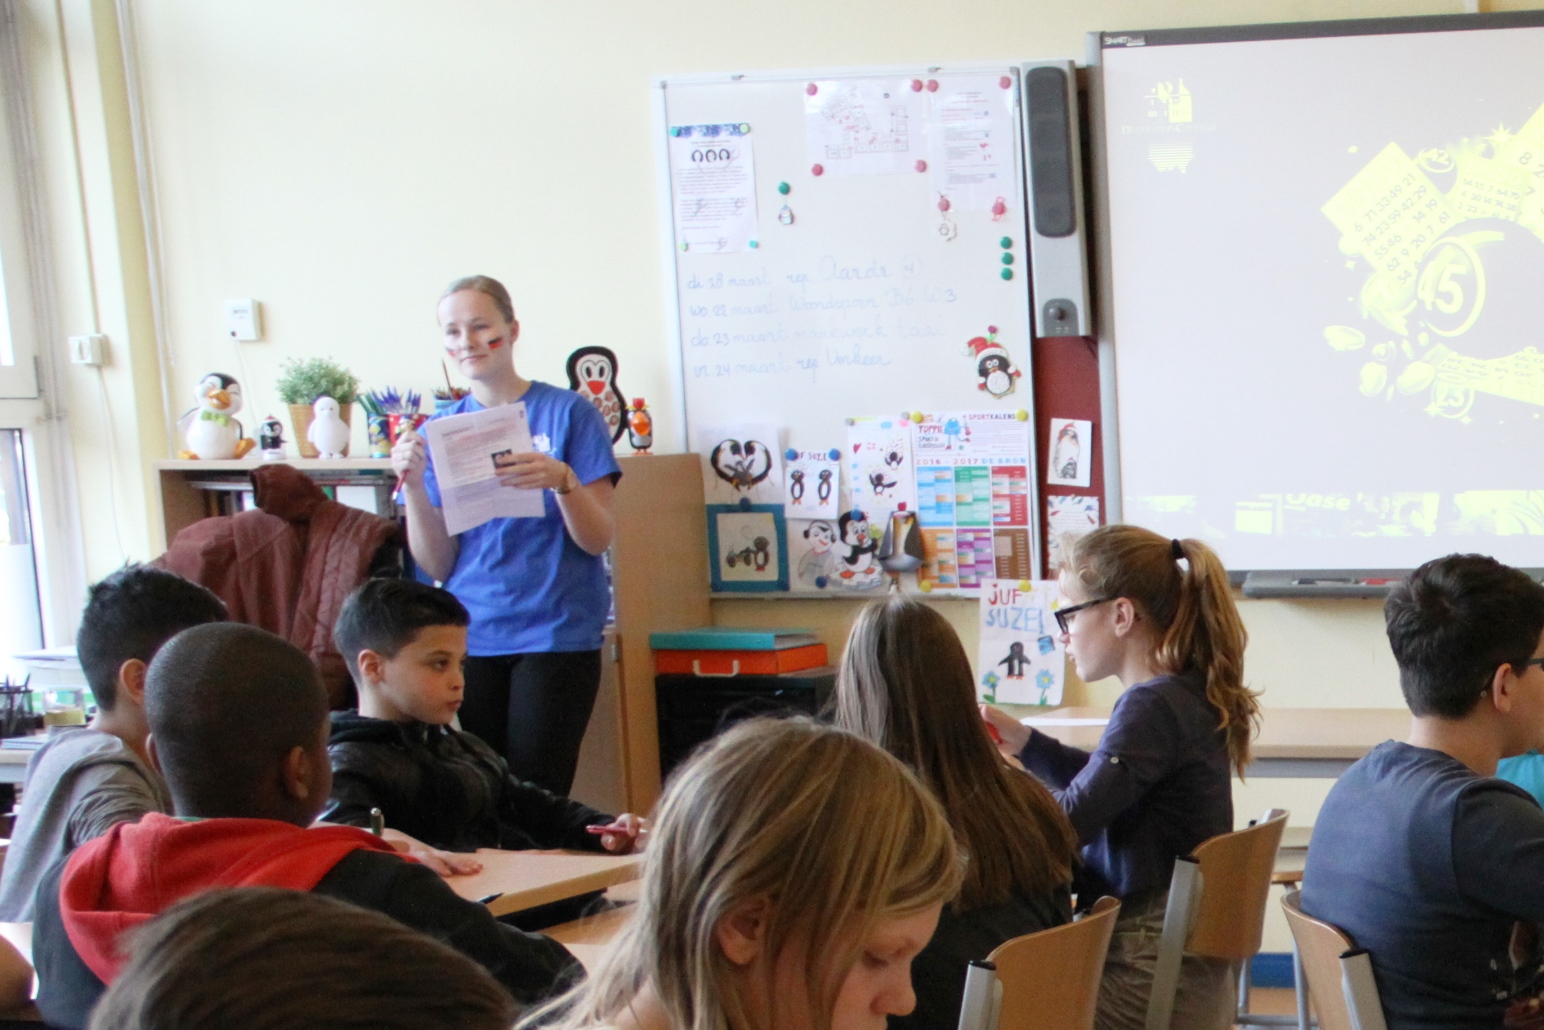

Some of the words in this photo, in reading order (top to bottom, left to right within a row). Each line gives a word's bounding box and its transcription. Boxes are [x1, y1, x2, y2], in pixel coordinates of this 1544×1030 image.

[1519, 152, 1532, 165] 8
[731, 293, 779, 315] maart
[712, 332, 730, 346] 23
[732, 321, 788, 343] maart
[715, 363, 731, 377] 24
[735, 351, 791, 373] maart
